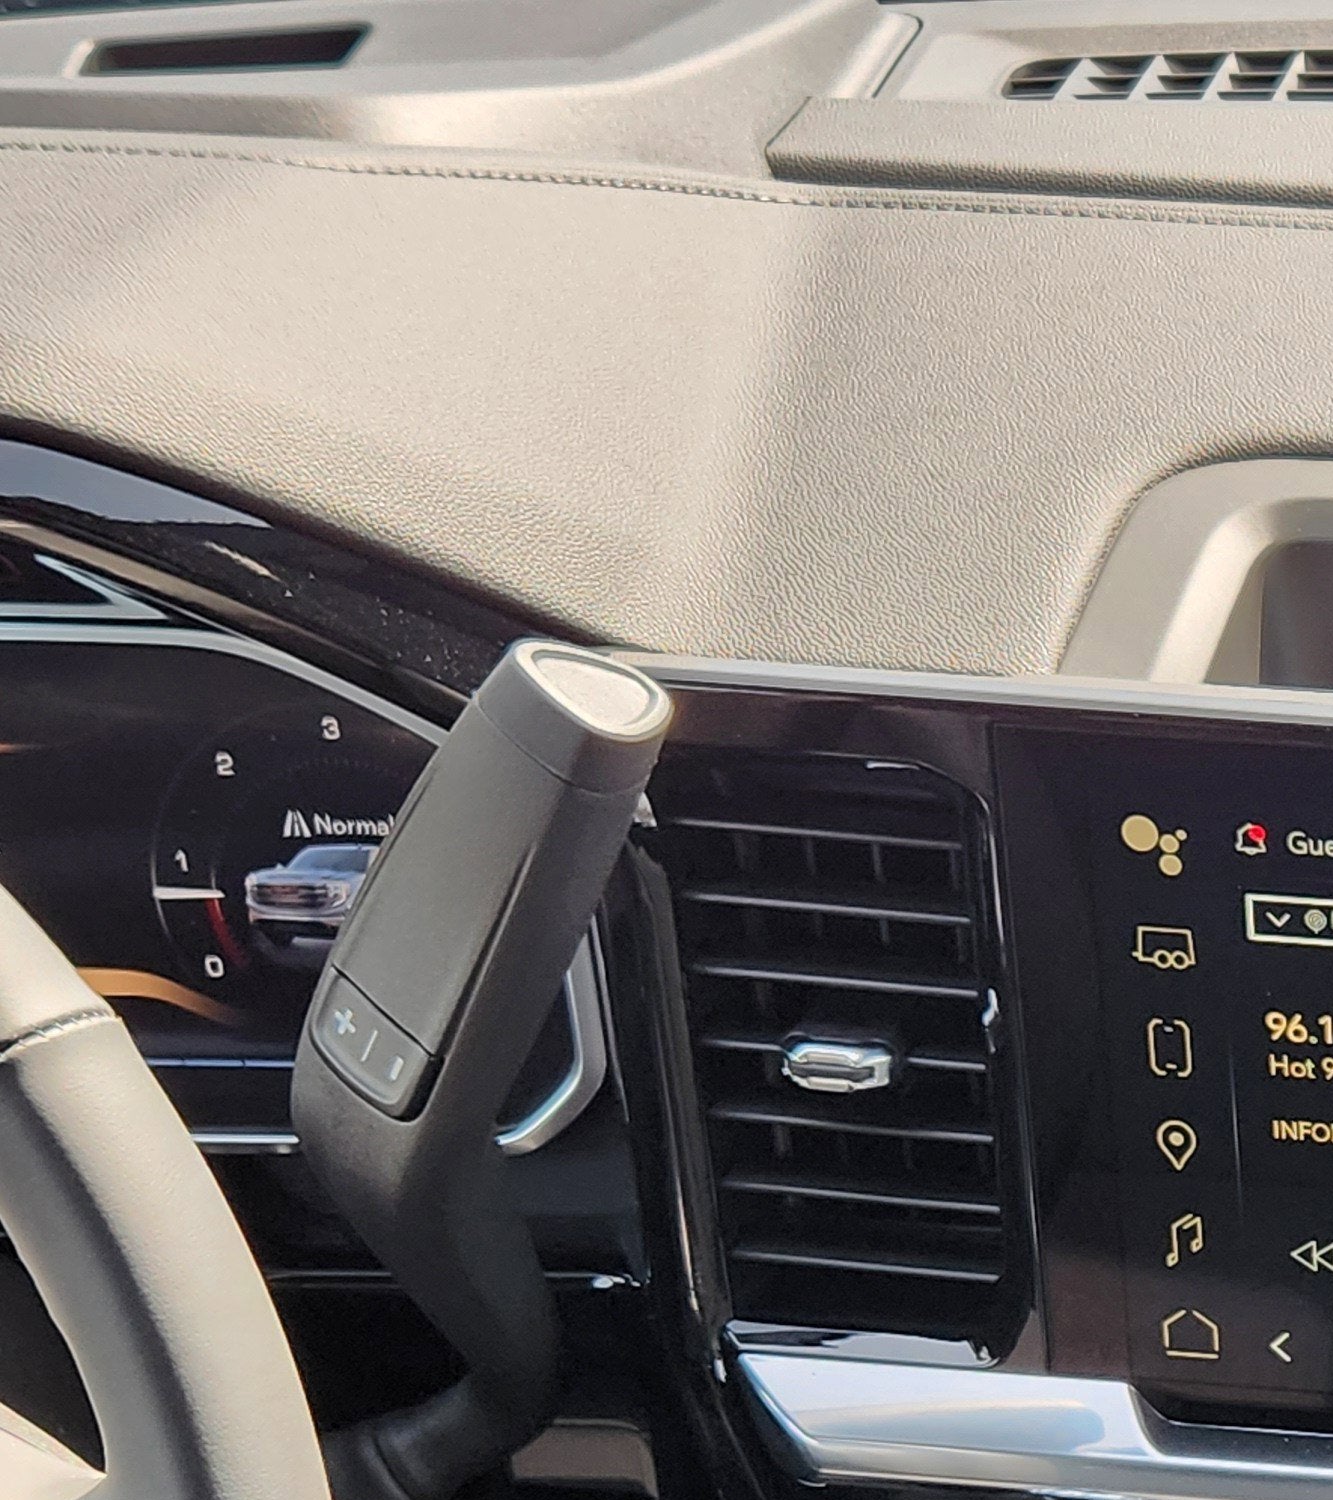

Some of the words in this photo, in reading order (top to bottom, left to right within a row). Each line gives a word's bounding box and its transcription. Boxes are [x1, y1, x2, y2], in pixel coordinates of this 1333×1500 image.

[320, 715, 341, 740] 3
[214, 751, 236, 776] 2
[174, 849, 189, 872] 1
[204, 955, 224, 978] 0
[1264, 1011, 1333, 1045] 96.1
[1268, 1054, 1317, 1079] Hot
